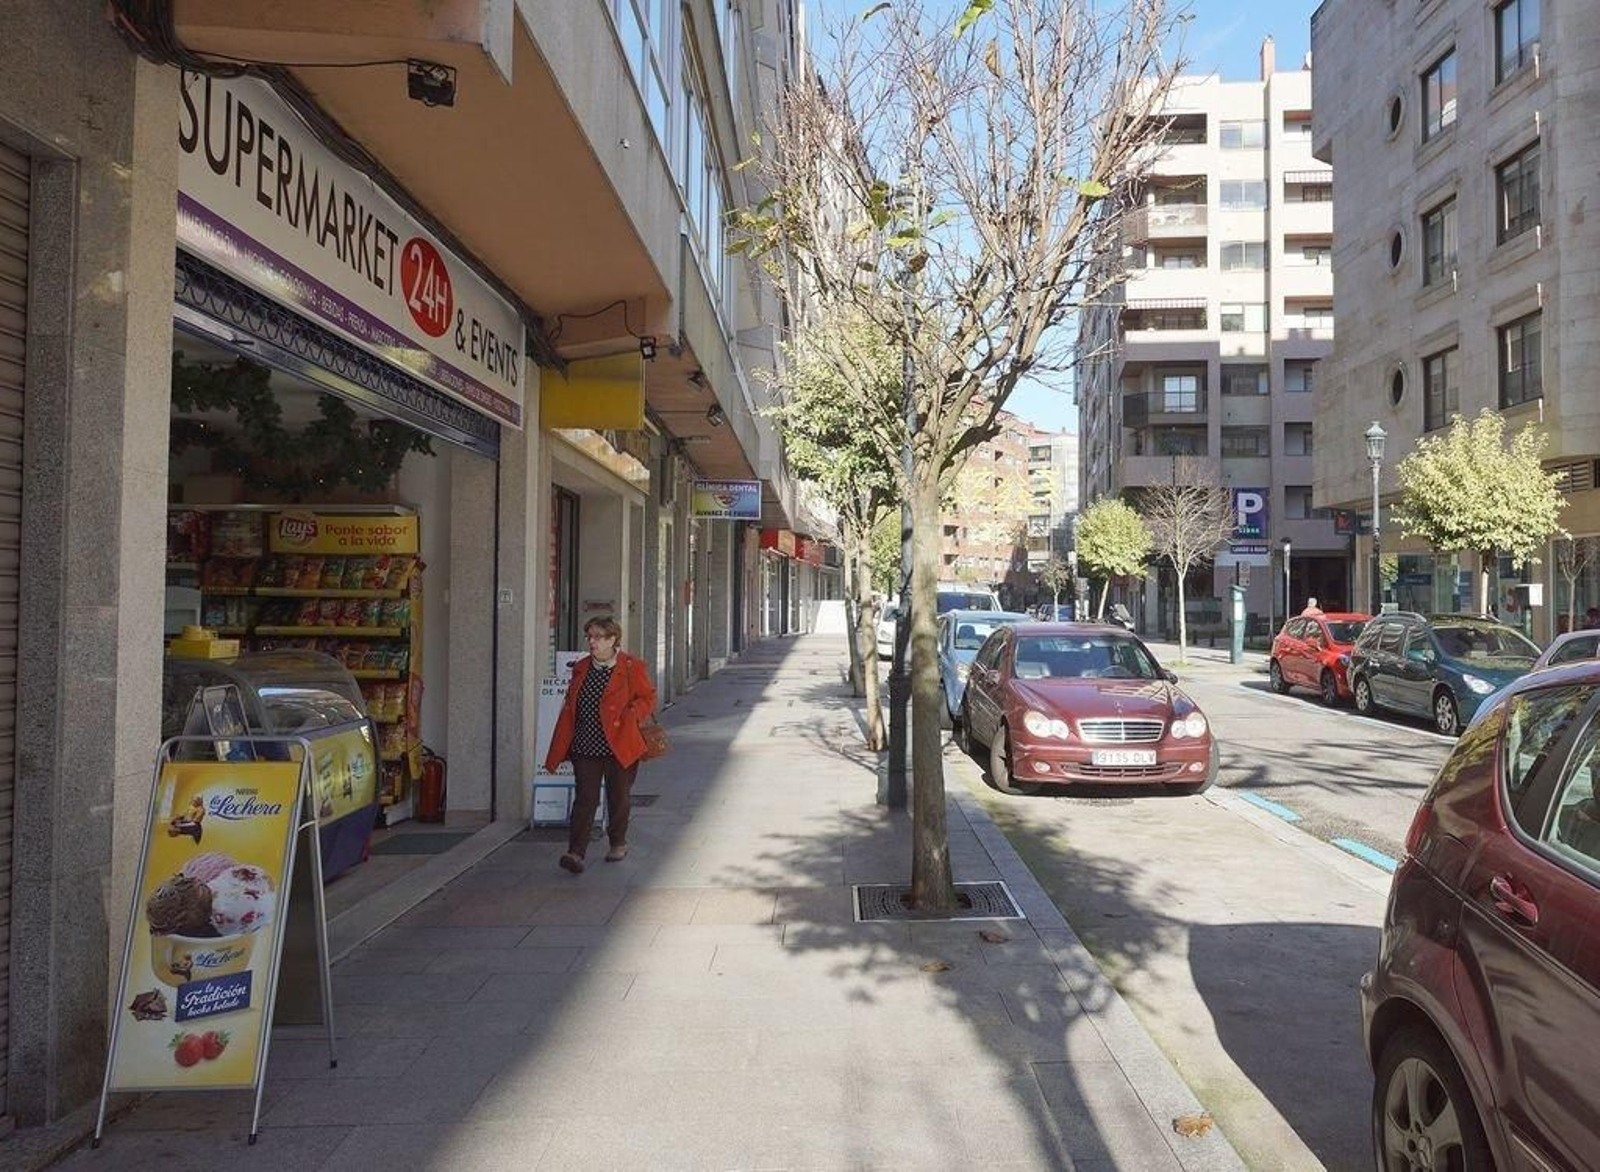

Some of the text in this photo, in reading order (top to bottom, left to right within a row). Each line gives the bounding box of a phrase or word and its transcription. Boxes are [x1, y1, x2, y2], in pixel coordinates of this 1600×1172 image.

[179, 67, 399, 296] SUPERMARKET
[408, 243, 448, 329] 24H
[471, 317, 518, 388] EVENTS
[729, 484, 758, 493] DENTAL
[1237, 492, 1263, 525] P
[351, 535, 363, 546] la
[366, 535, 396, 547] vida
[368, 524, 408, 536] sabor
[209, 794, 282, 820] Lechera
[181, 983, 247, 1010] Tradición
